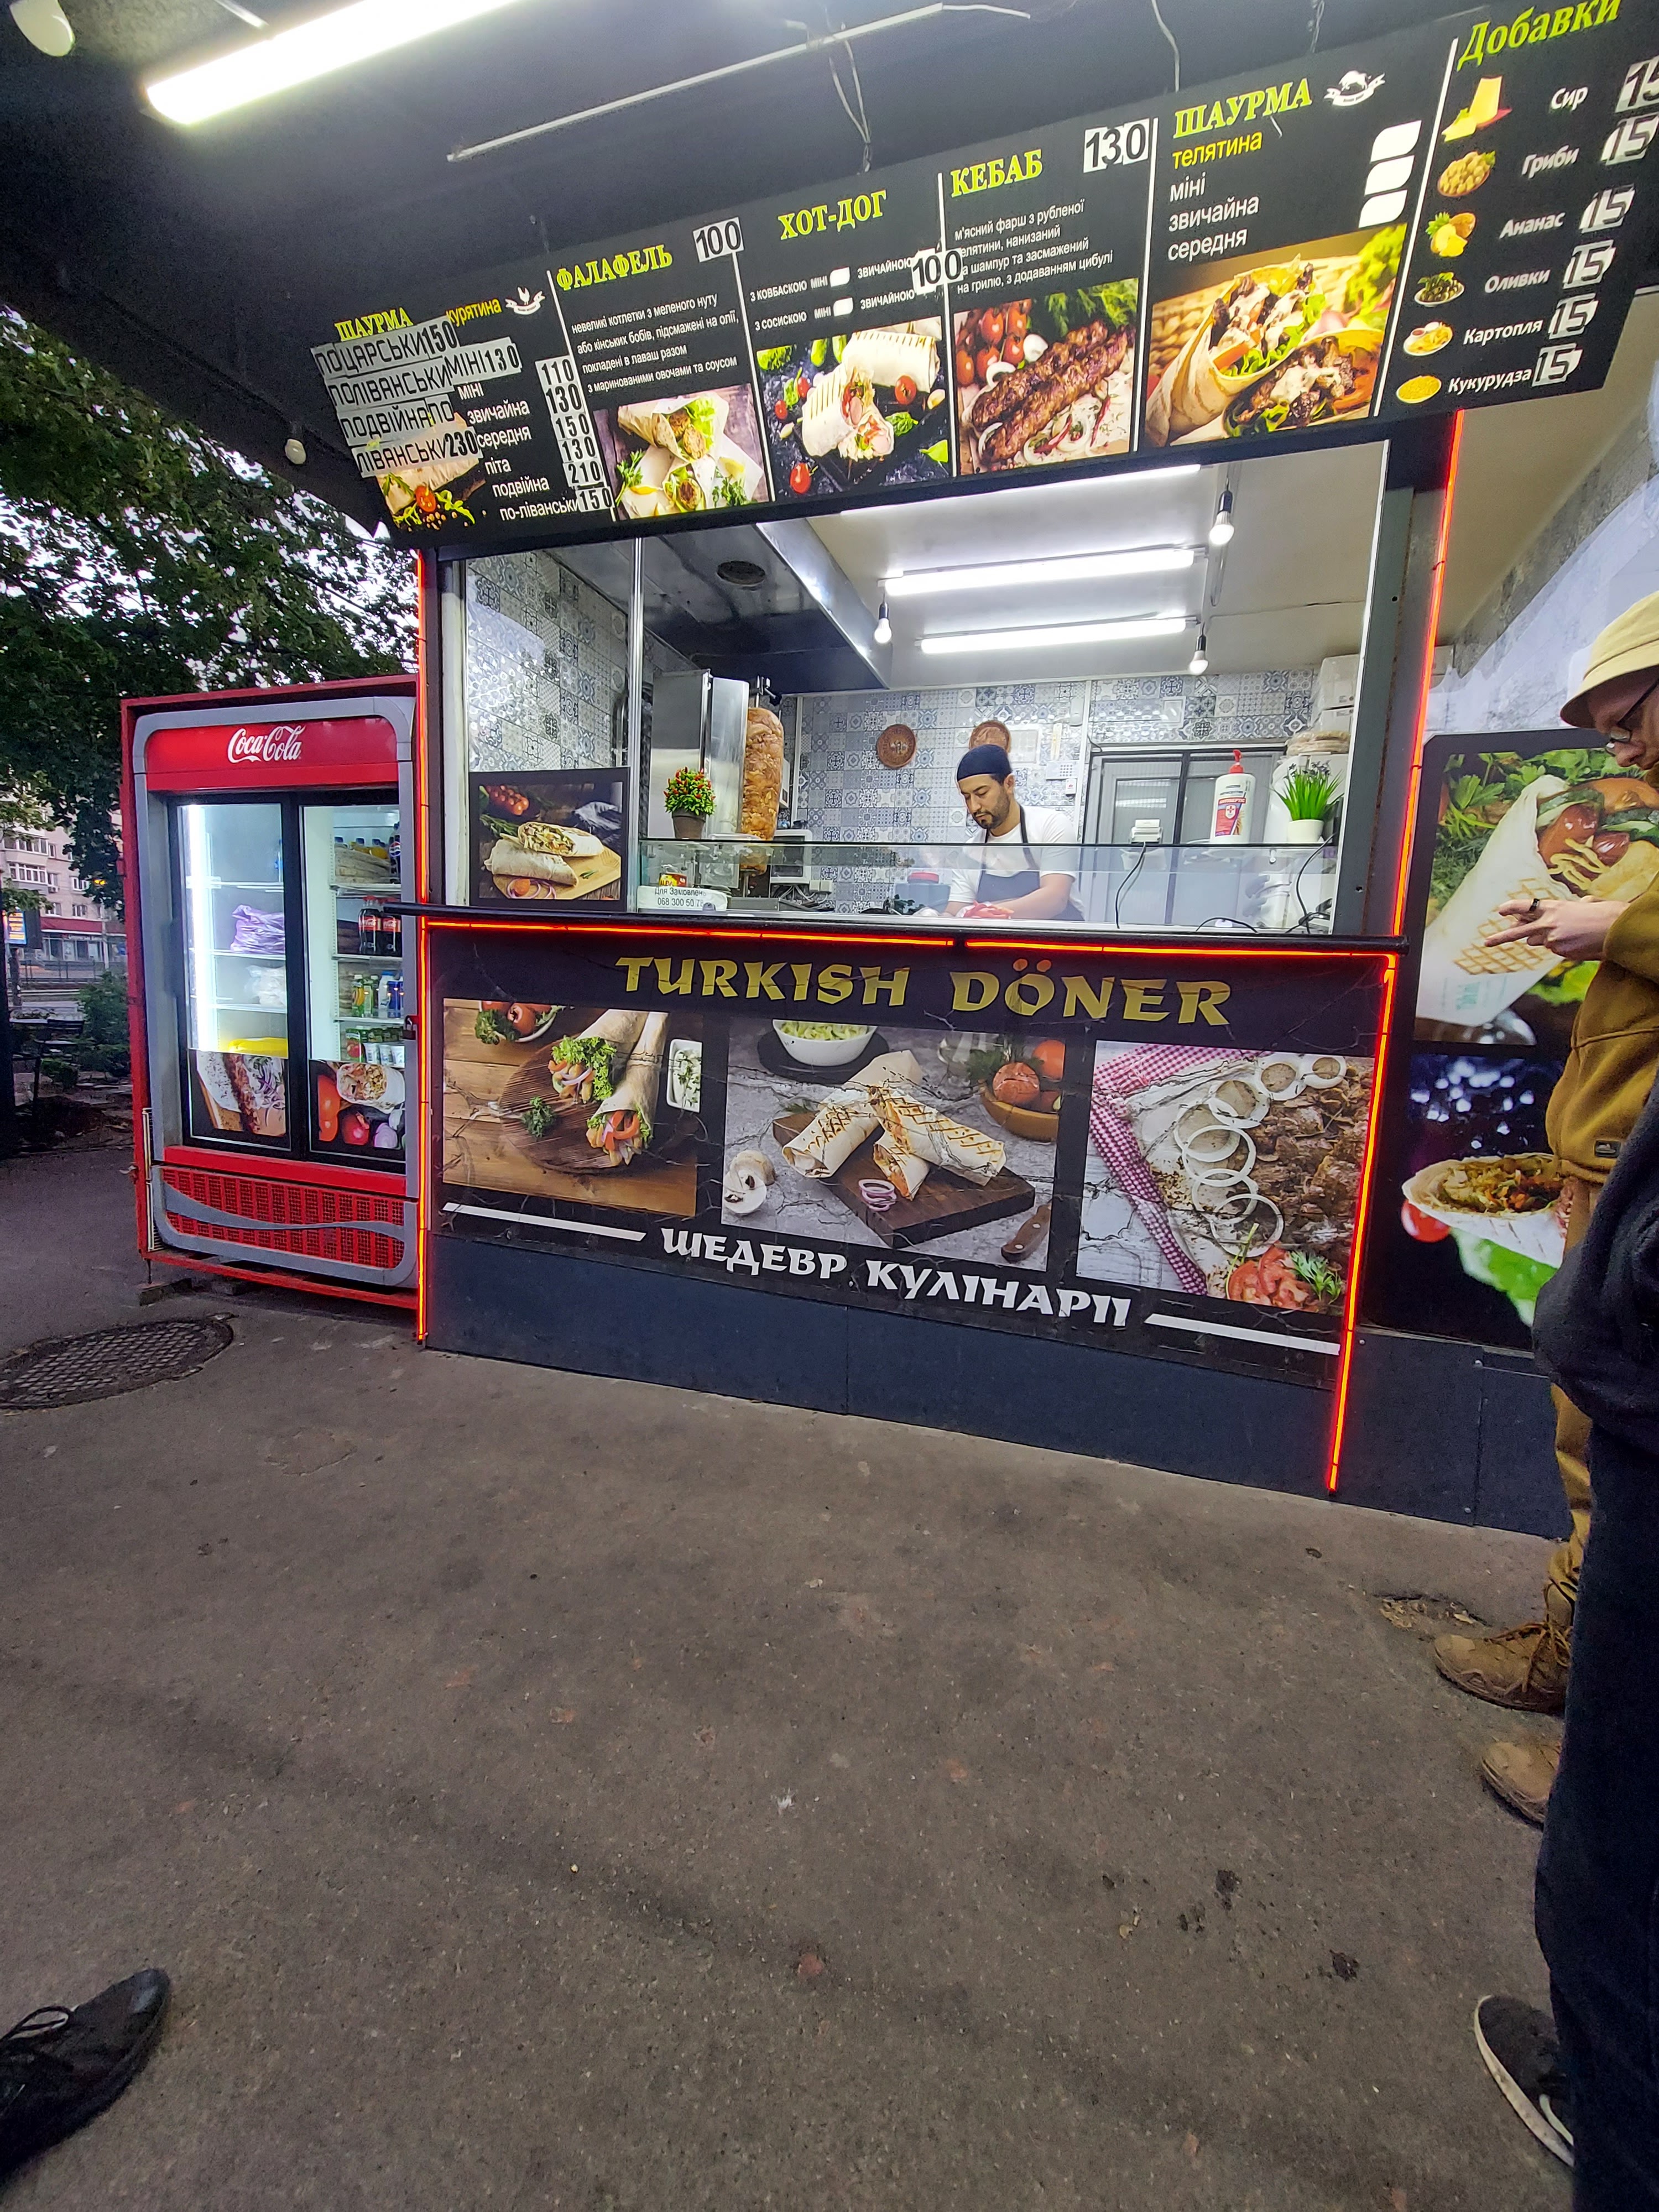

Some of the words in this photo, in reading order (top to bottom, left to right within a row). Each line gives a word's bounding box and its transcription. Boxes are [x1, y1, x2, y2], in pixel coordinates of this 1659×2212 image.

[1457, 0, 1622, 72] Добавки
[1173, 78, 1312, 138] ШАУРМА
[1551, 87, 1588, 111] Сир
[1086, 123, 1145, 169] 130
[1172, 132, 1262, 169] телятина
[1609, 116, 1658, 160] 15
[951, 149, 1043, 198] КЕБАБ
[1522, 144, 1579, 179] Гриби
[1170, 171, 1206, 202] міні
[778, 190, 887, 240] ХОТ-ДОГ
[955, 221, 994, 241] м'ясний
[996, 215, 1026, 234] фарш
[1029, 213, 1035, 225] з
[1037, 199, 1085, 225] рубленої
[1168, 196, 1260, 232] звичайна
[1588, 184, 1634, 228] 15
[696, 221, 742, 258] 100
[961, 240, 1004, 258] елятини,
[1006, 224, 1061, 248] нанизаний
[1499, 212, 1566, 239] Ананас
[971, 257, 1010, 274] шампур
[1012, 254, 1023, 265] та
[1026, 237, 1089, 262] засмажений
[1168, 229, 1248, 262] середня
[556, 244, 673, 291] ФАЛАФЕЛЬ
[757, 280, 808, 301] КОВБАСКОЮ
[810, 275, 828, 289] МІНІ
[857, 257, 912, 279] ЗВИЧАЙНОЮ
[912, 251, 962, 288] 100
[957, 283, 969, 294] на
[972, 276, 1004, 294] грилю,
[1007, 274, 1012, 284] з
[1014, 260, 1076, 285] додаванням
[1079, 250, 1113, 270] цибулі
[1485, 269, 1551, 293] Оливки
[1567, 244, 1613, 284] 15
[335, 307, 414, 341] ШАУРМА
[446, 299, 502, 327] курятина
[571, 315, 608, 334] невеликі
[608, 310, 646, 326] котлетки
[646, 308, 653, 319] з
[653, 299, 696, 317] меленого
[697, 293, 718, 310] нуту
[761, 311, 807, 330] СОСИСКОЮ
[814, 306, 832, 319] МІНІ
[860, 289, 915, 310] ЗВИЧАЙНОЮ
[1552, 299, 1595, 339] 15
[577, 341, 593, 354] або
[594, 336, 628, 351] кінських
[629, 329, 655, 343] бобів,
[655, 317, 705, 339] підсмажені
[706, 316, 718, 328] на
[719, 310, 739, 325] олії,
[1463, 319, 1544, 346] Картопля
[541, 359, 575, 385] 110
[582, 355, 623, 374] покладені
[624, 356, 630, 366] в
[632, 349, 659, 365] лаваш
[660, 345, 687, 361] разом
[587, 384, 593, 393] з
[593, 372, 655, 392] маринованими
[655, 365, 692, 380] овочами
[693, 362, 704, 373] та
[705, 356, 738, 372] соусом
[1535, 348, 1576, 382] 15
[457, 382, 484, 400] міні
[545, 383, 582, 414] 130
[1448, 369, 1532, 395] Кукурудза
[467, 399, 530, 424] звичайна
[555, 414, 590, 439] 150
[477, 426, 533, 449] середня
[561, 436, 596, 462] 130
[484, 457, 512, 475] піта
[568, 461, 602, 484] 210
[492, 476, 550, 498] подвійна
[579, 488, 612, 510] 150
[499, 498, 580, 521] по-ліванськи
[227, 725, 306, 763] Coca-Cola
[655, 887, 667, 895] Для
[658, 897, 670, 906] 068
[671, 898, 684, 906] 300
[686, 899, 695, 907] 50
[614, 956, 911, 1007] TURKISH
[951, 958, 1232, 1027] DÖNER
[660, 1228, 848, 1280] ШЕДЕВР
